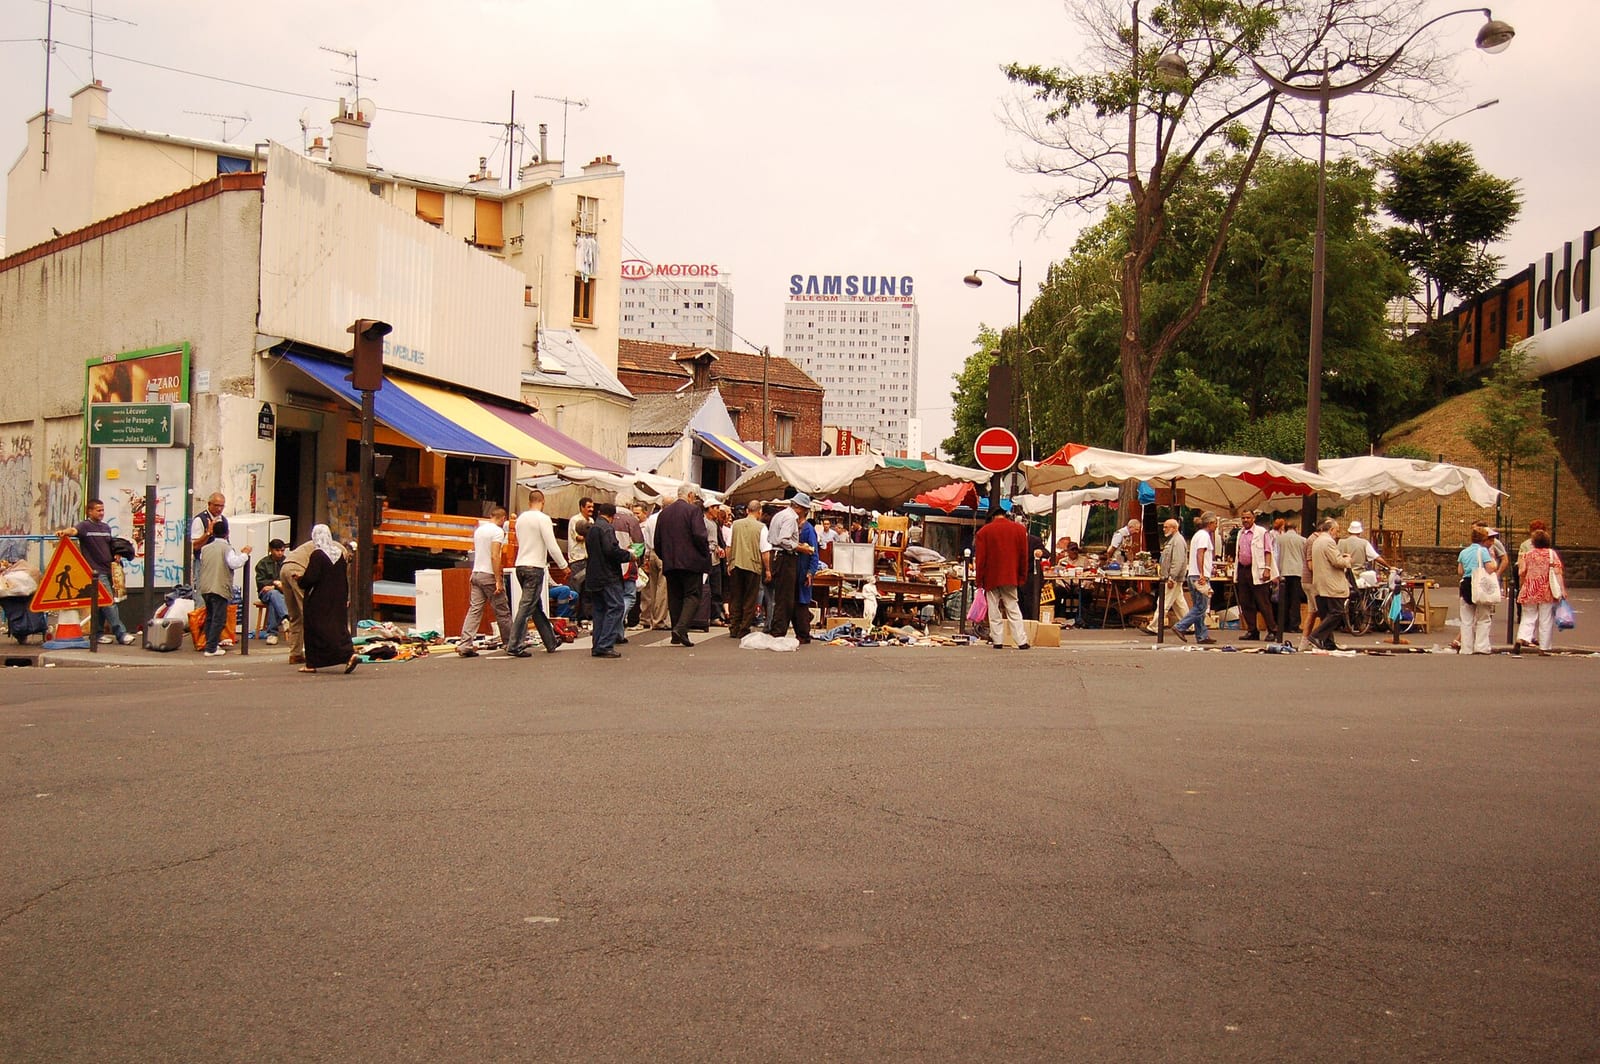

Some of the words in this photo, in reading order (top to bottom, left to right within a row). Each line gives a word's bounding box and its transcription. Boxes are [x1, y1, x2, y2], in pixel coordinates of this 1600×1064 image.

[620, 265, 646, 276] KIA
[656, 264, 719, 276] MOTORS
[789, 274, 914, 296] SAMSUNG
[145, 375, 180, 390] AZZARO
[132, 416, 154, 425] Passage
